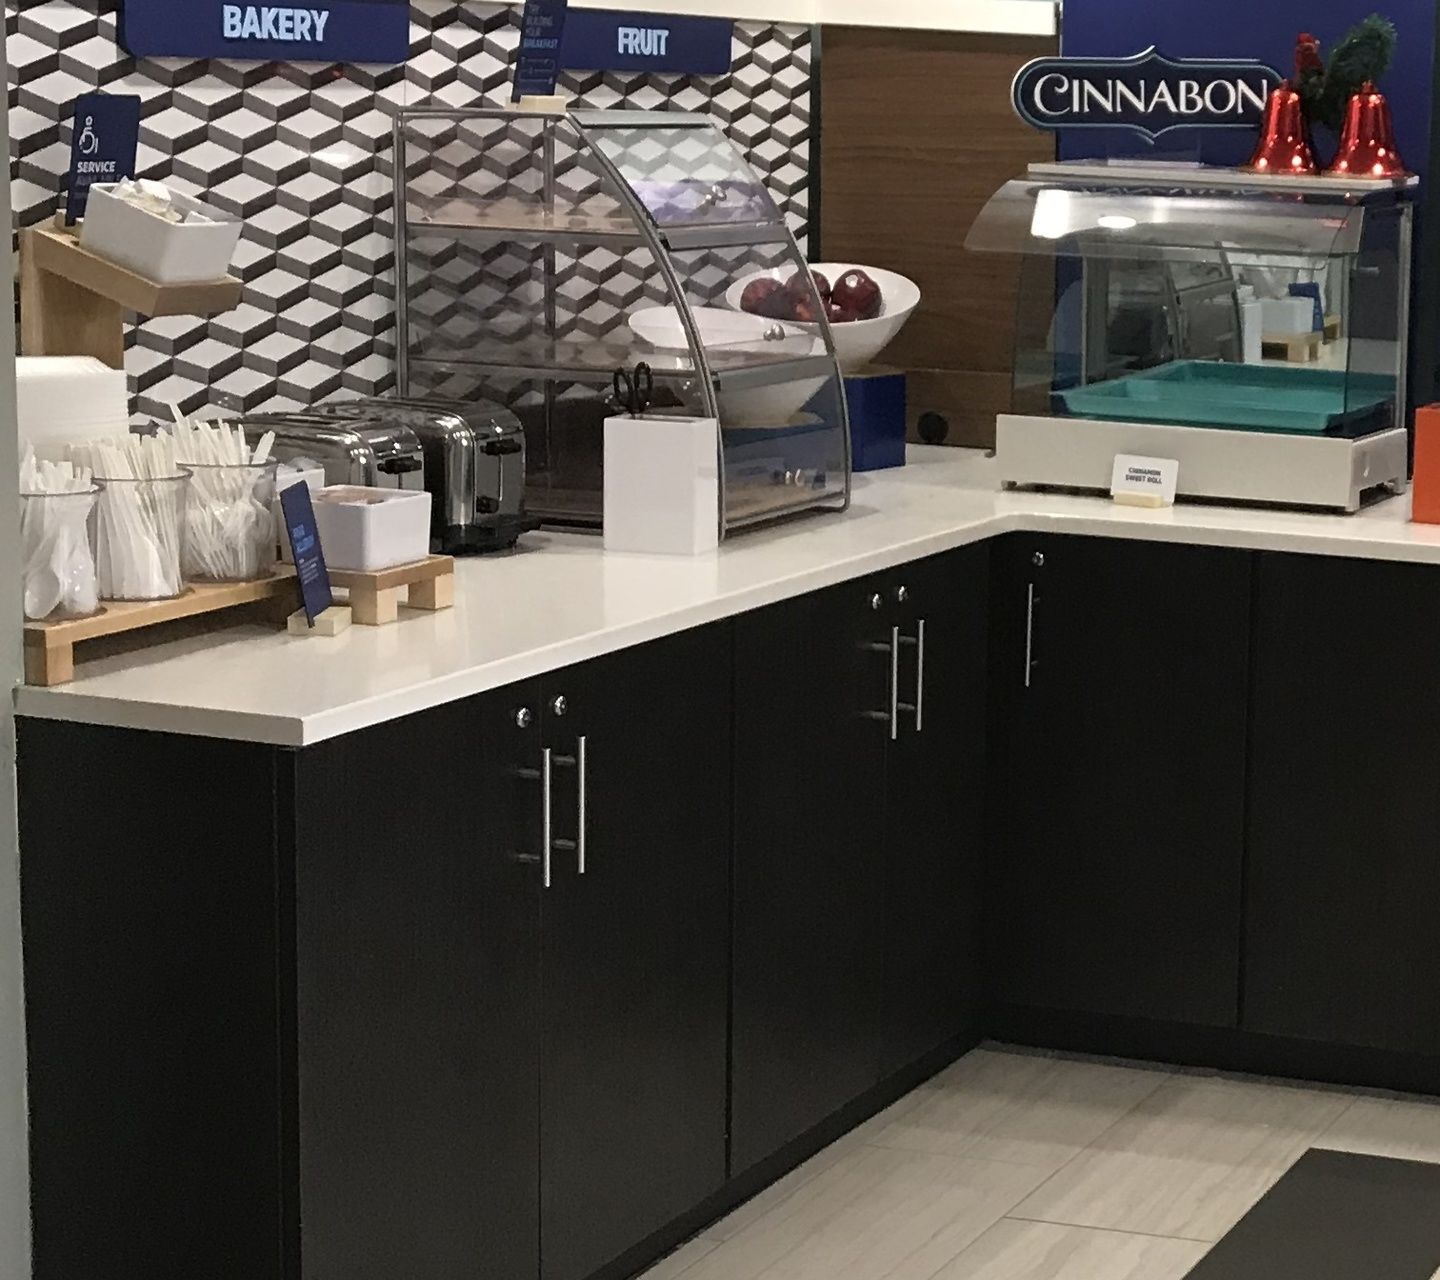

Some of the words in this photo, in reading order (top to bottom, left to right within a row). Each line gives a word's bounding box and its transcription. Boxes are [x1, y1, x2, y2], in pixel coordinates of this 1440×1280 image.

[222, 4, 330, 42] BAKERY
[617, 26, 669, 56] FRUIT
[1033, 73, 1268, 115] CINNABON
[77, 161, 116, 173] SERVICE
